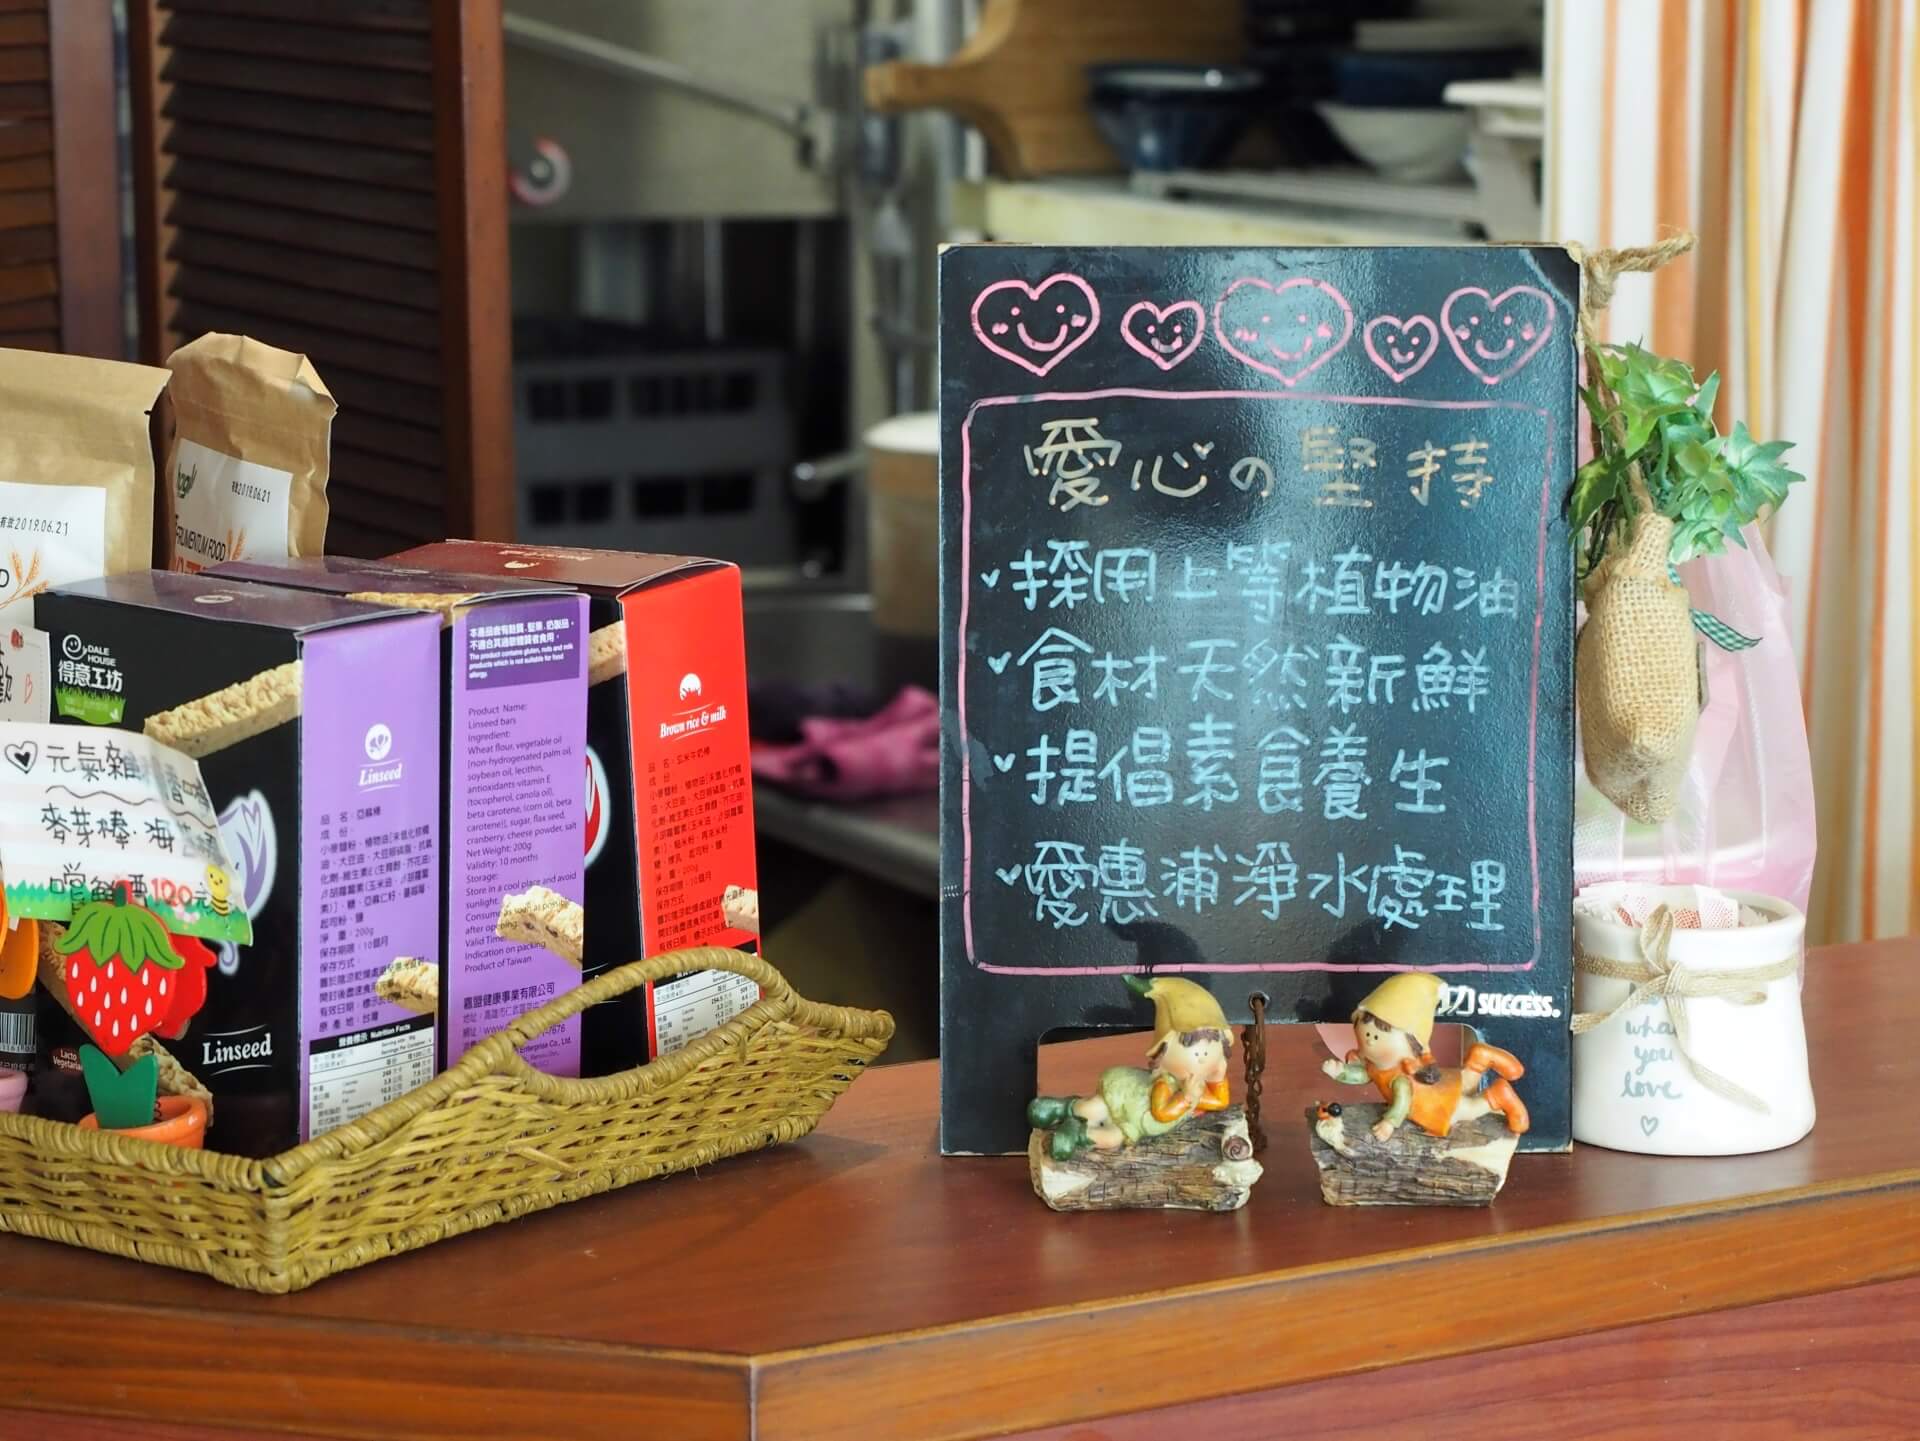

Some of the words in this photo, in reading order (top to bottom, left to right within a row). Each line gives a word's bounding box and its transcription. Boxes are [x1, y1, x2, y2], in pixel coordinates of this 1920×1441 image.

[1024, 417, 1494, 511] 愛心の堅持
[1009, 539, 1519, 622] 採用上等植物油
[87, 645, 110, 656] DALE
[88, 655, 116, 667] HOUSE
[1018, 627, 1491, 712] 食材天然新鮮
[58, 659, 123, 693] 得意工坊
[468, 705, 499, 716] Product
[468, 718, 498, 730] Linseed
[500, 716, 516, 726] bars
[660, 723, 685, 739] Brown
[686, 715, 699, 730] rice
[710, 705, 727, 723] milk
[468, 745, 493, 755] Wheat
[516, 737, 552, 750] vegetable
[553, 736, 562, 744] oil
[543, 750, 560, 761] palm
[359, 763, 402, 786] Linseed
[467, 770, 500, 782] soybean
[1026, 715, 1449, 820] 提倡素食養生
[467, 781, 515, 794] antioxidants
[517, 777, 545, 788] vitamin
[516, 790, 540, 801] canola
[467, 809, 485, 820] beta
[556, 798, 572, 807] beta
[507, 828, 533, 840] cheese
[466, 848, 480, 859] Net
[513, 842, 532, 852] 200g
[500, 857, 508, 865] 10
[510, 854, 538, 864] months
[466, 887, 486, 897] Store
[488, 885, 495, 893] in
[503, 880, 520, 891] cool
[542, 875, 556, 885] and
[557, 871, 577, 882] avoid
[1026, 839, 1507, 930] 愛惠浦淨水處理
[465, 925, 483, 935] after
[465, 936, 485, 947] Valid
[465, 947, 504, 960] Indication
[506, 944, 516, 953] on
[517, 940, 546, 953] packing
[465, 960, 495, 973] Product
[497, 958, 505, 967] of
[507, 955, 532, 966] Taiwan
[1625, 1015, 1676, 1038] wha
[60, 1048, 78, 1060] Lacto
[202, 1032, 273, 1065] Linseed
[1634, 1045, 1674, 1076] you
[1620, 1071, 1683, 1099] love
